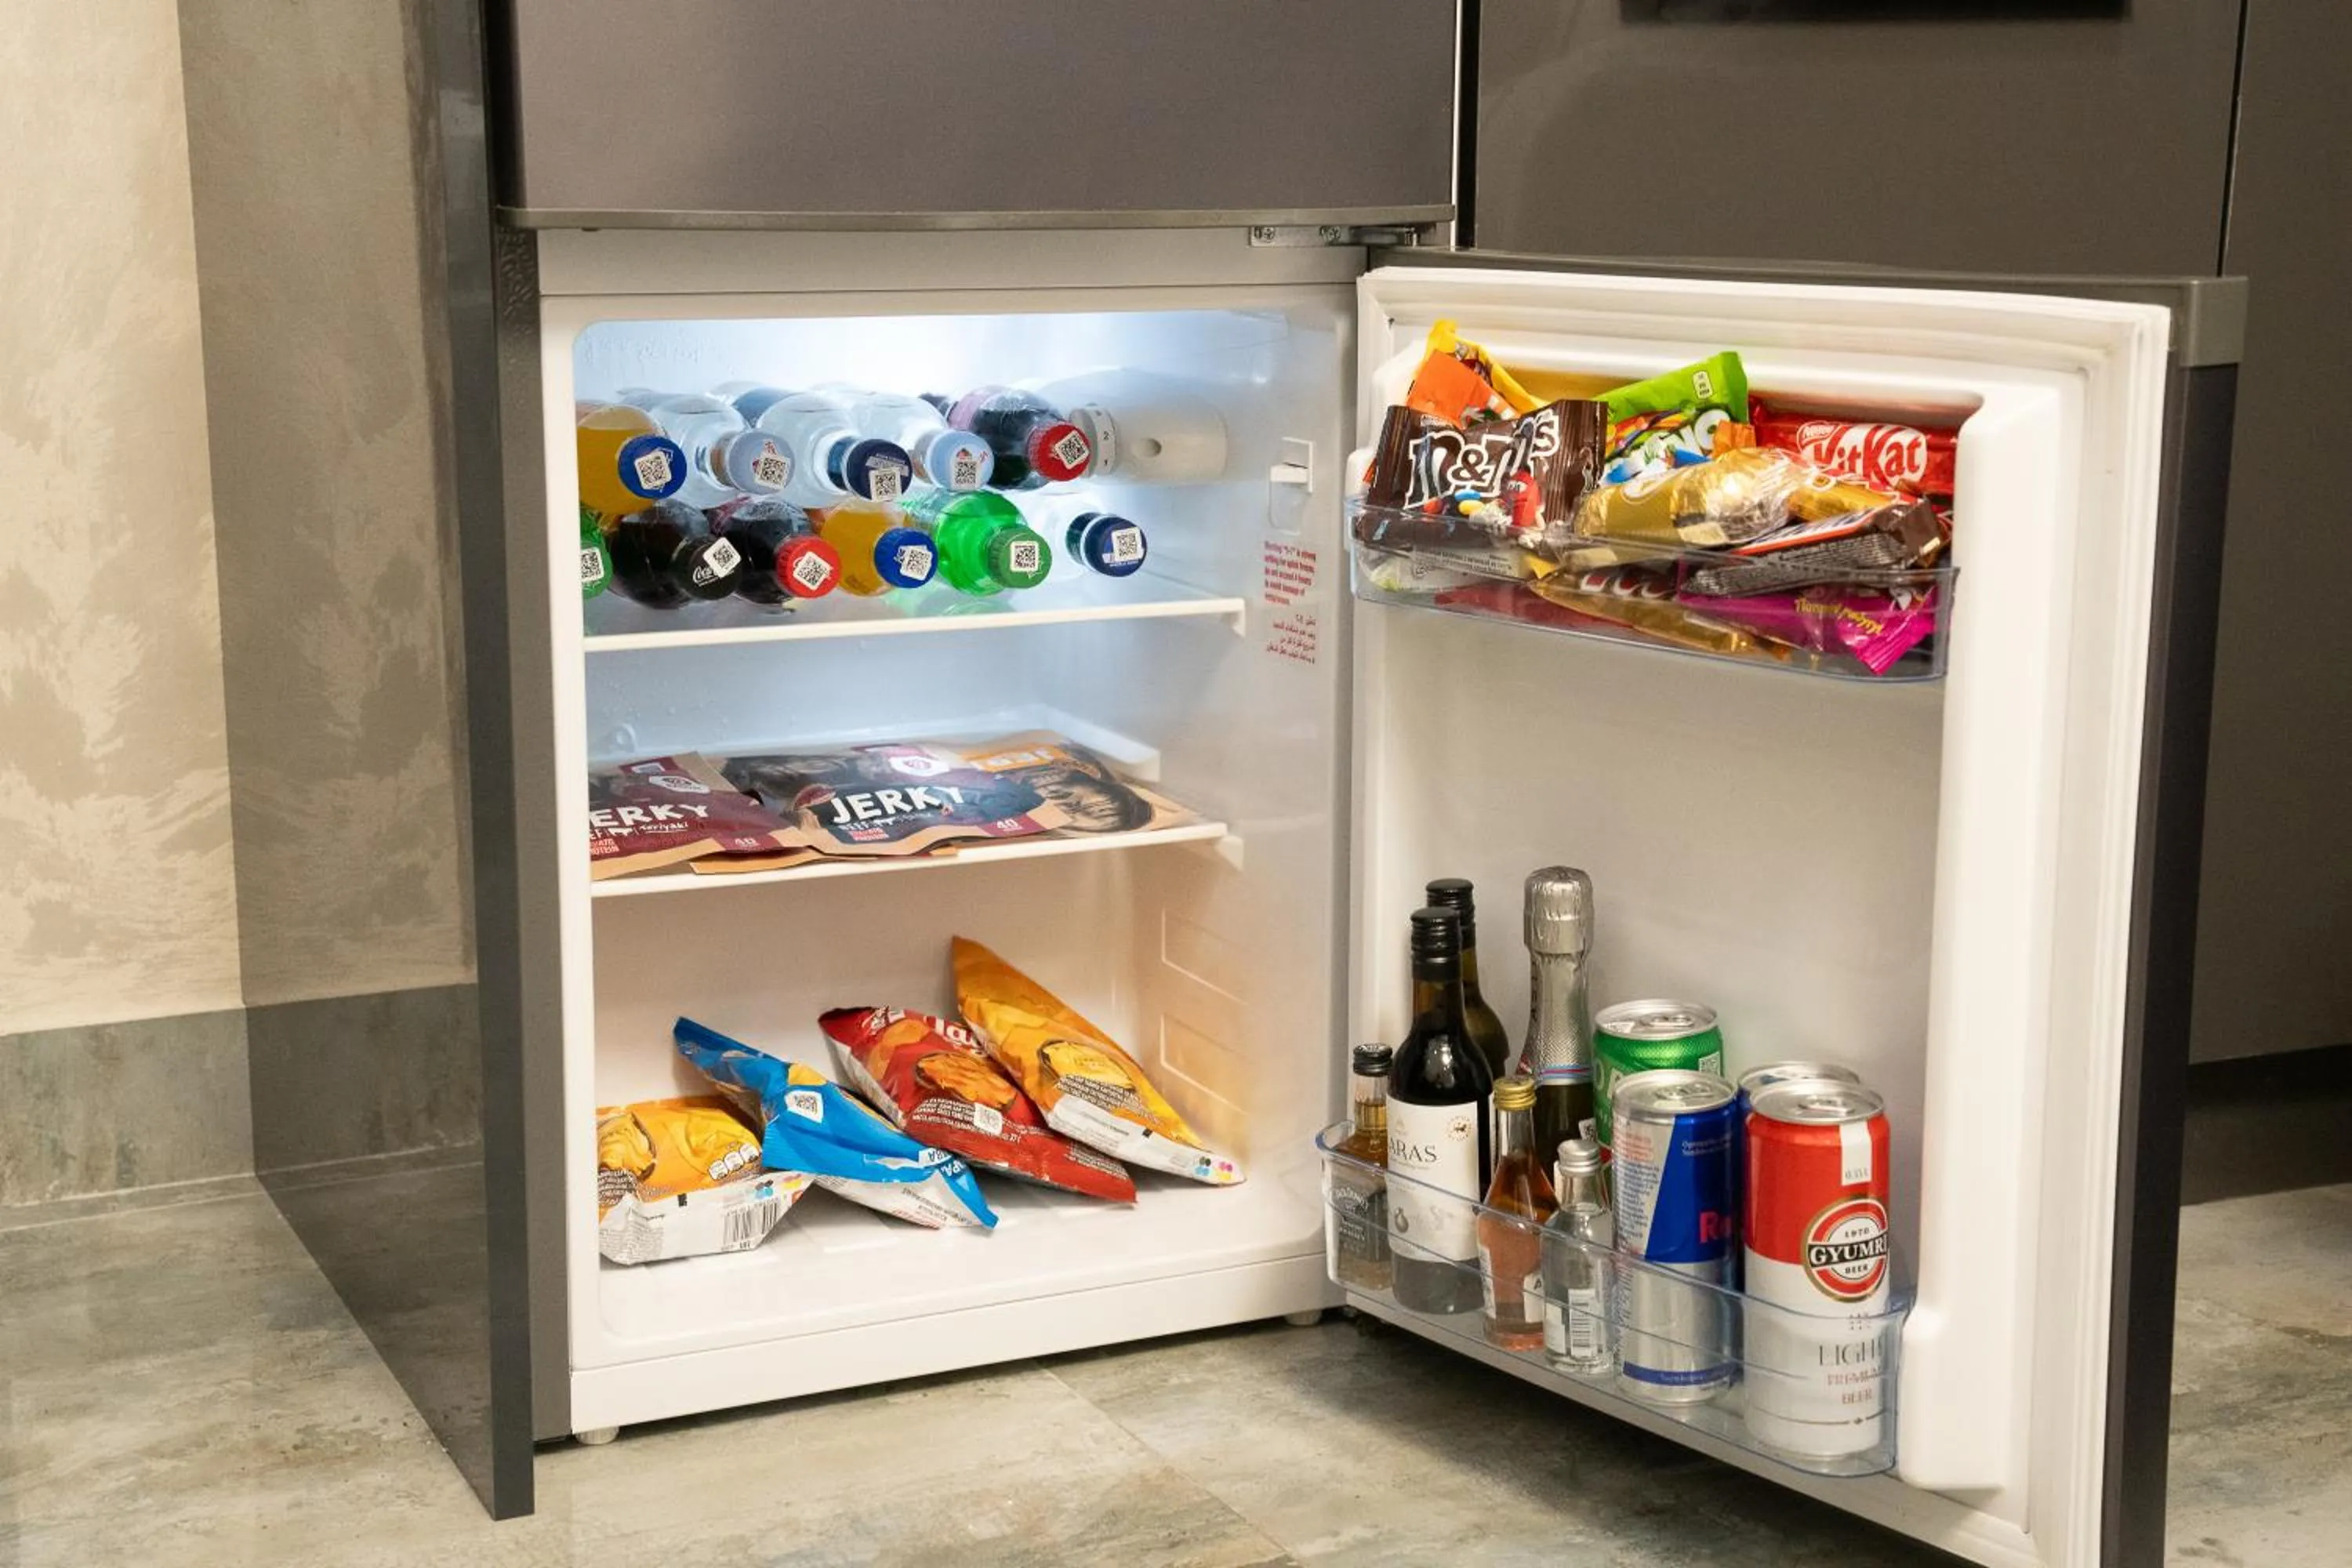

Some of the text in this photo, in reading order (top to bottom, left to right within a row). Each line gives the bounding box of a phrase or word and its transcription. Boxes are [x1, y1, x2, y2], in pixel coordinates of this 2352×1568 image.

[1103, 430, 1109, 440] 2
[1813, 424, 1924, 489] KitKat
[590, 804, 710, 828] ERKY
[831, 786, 964, 824] JERKY
[1388, 1137, 1438, 1163] ARAS
[1810, 1235, 1886, 1267] GYUMRI
[1845, 1264, 1869, 1275] BEER
